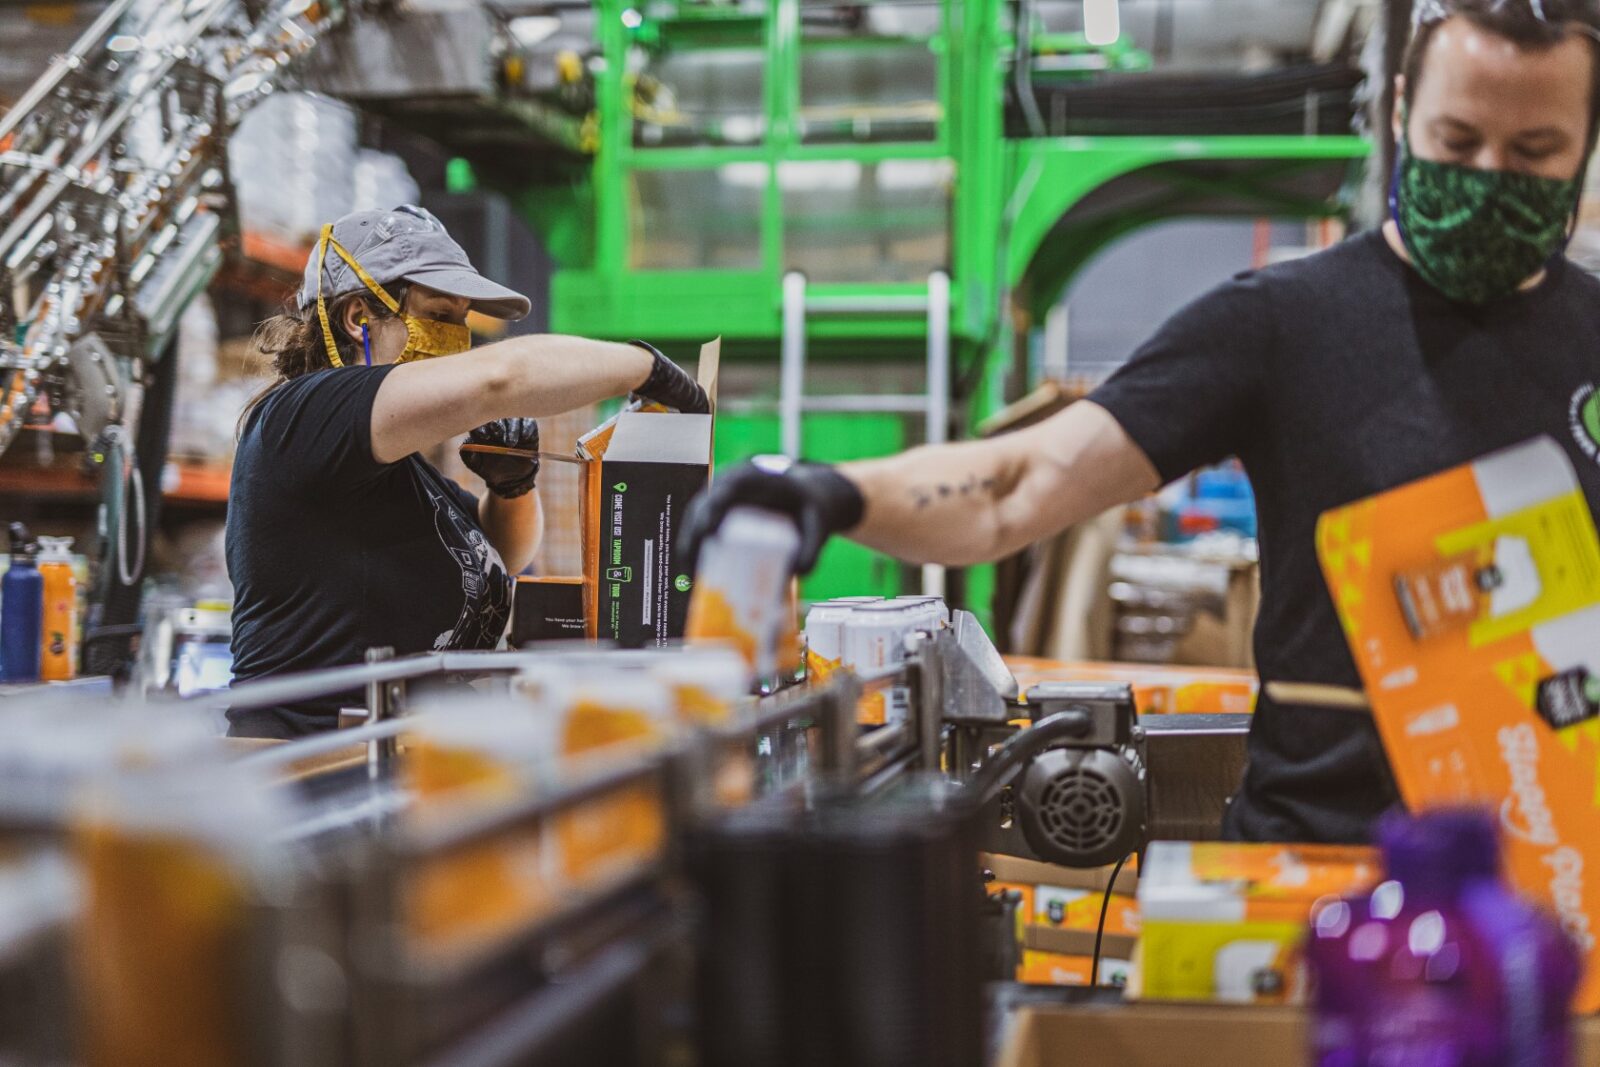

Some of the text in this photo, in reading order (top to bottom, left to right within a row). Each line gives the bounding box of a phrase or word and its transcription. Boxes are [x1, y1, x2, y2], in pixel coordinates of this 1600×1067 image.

[613, 494, 623, 510] COME
[613, 510, 623, 525] VISIT
[613, 538, 622, 565] TAPROOM
[613, 570, 622, 578] &
[611, 583, 620, 598] TOUR
